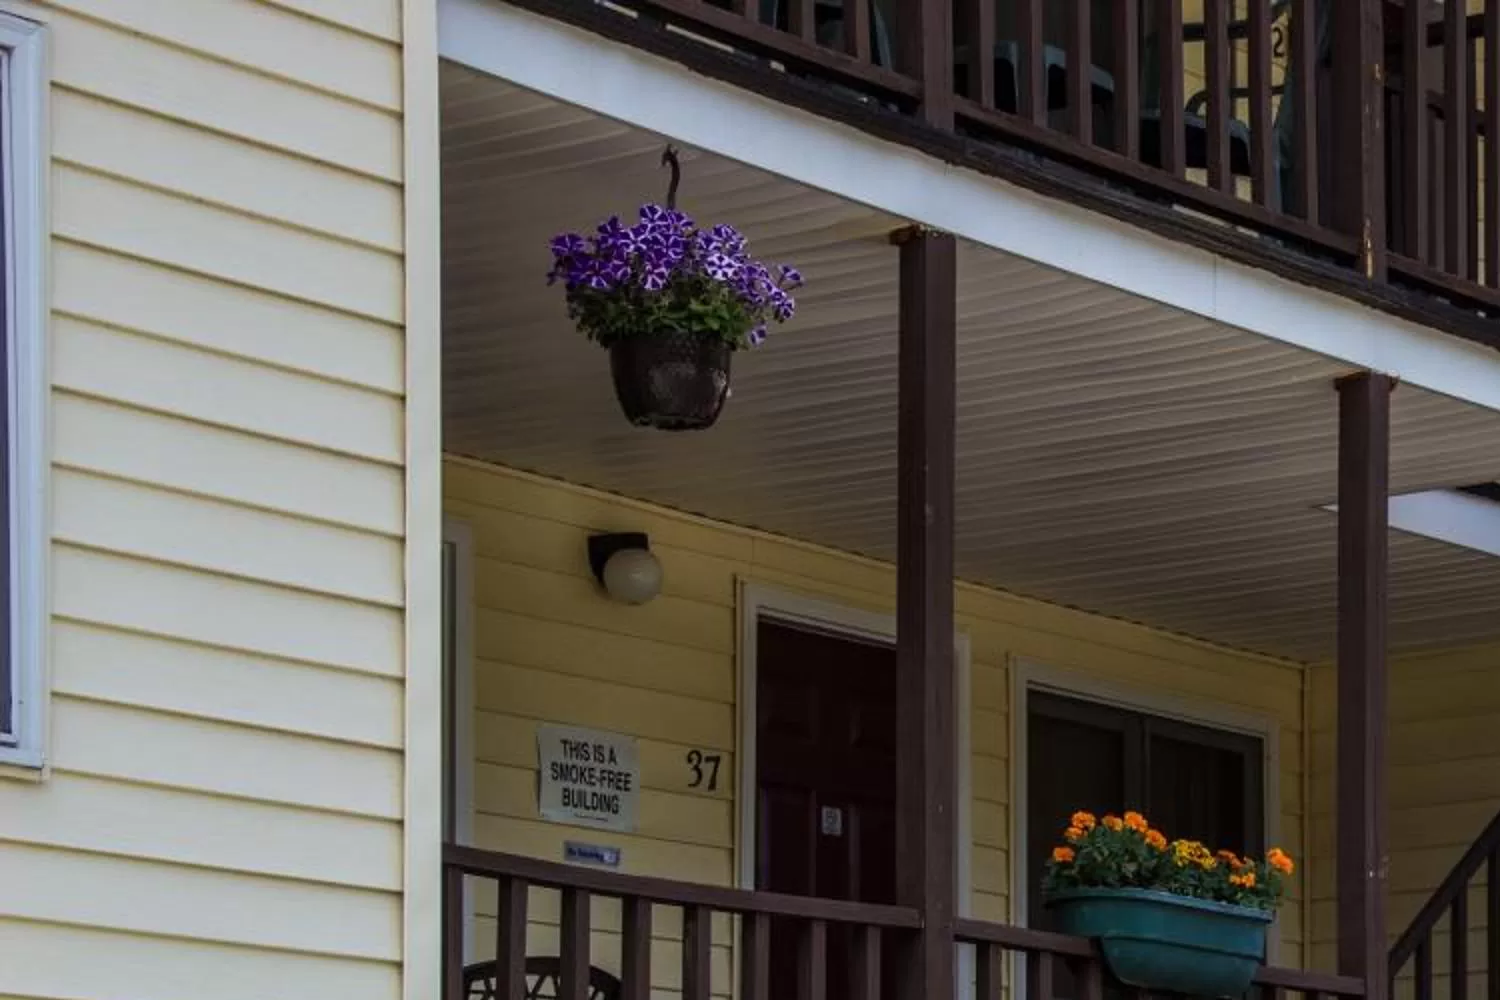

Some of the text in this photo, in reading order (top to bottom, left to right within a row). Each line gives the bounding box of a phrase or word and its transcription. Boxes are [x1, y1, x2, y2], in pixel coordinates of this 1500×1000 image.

[560, 739, 618, 766] THIS IS A
[551, 761, 632, 792] SMOKE-FREE
[687, 749, 721, 792] 37
[562, 787, 619, 815] BUILDING
